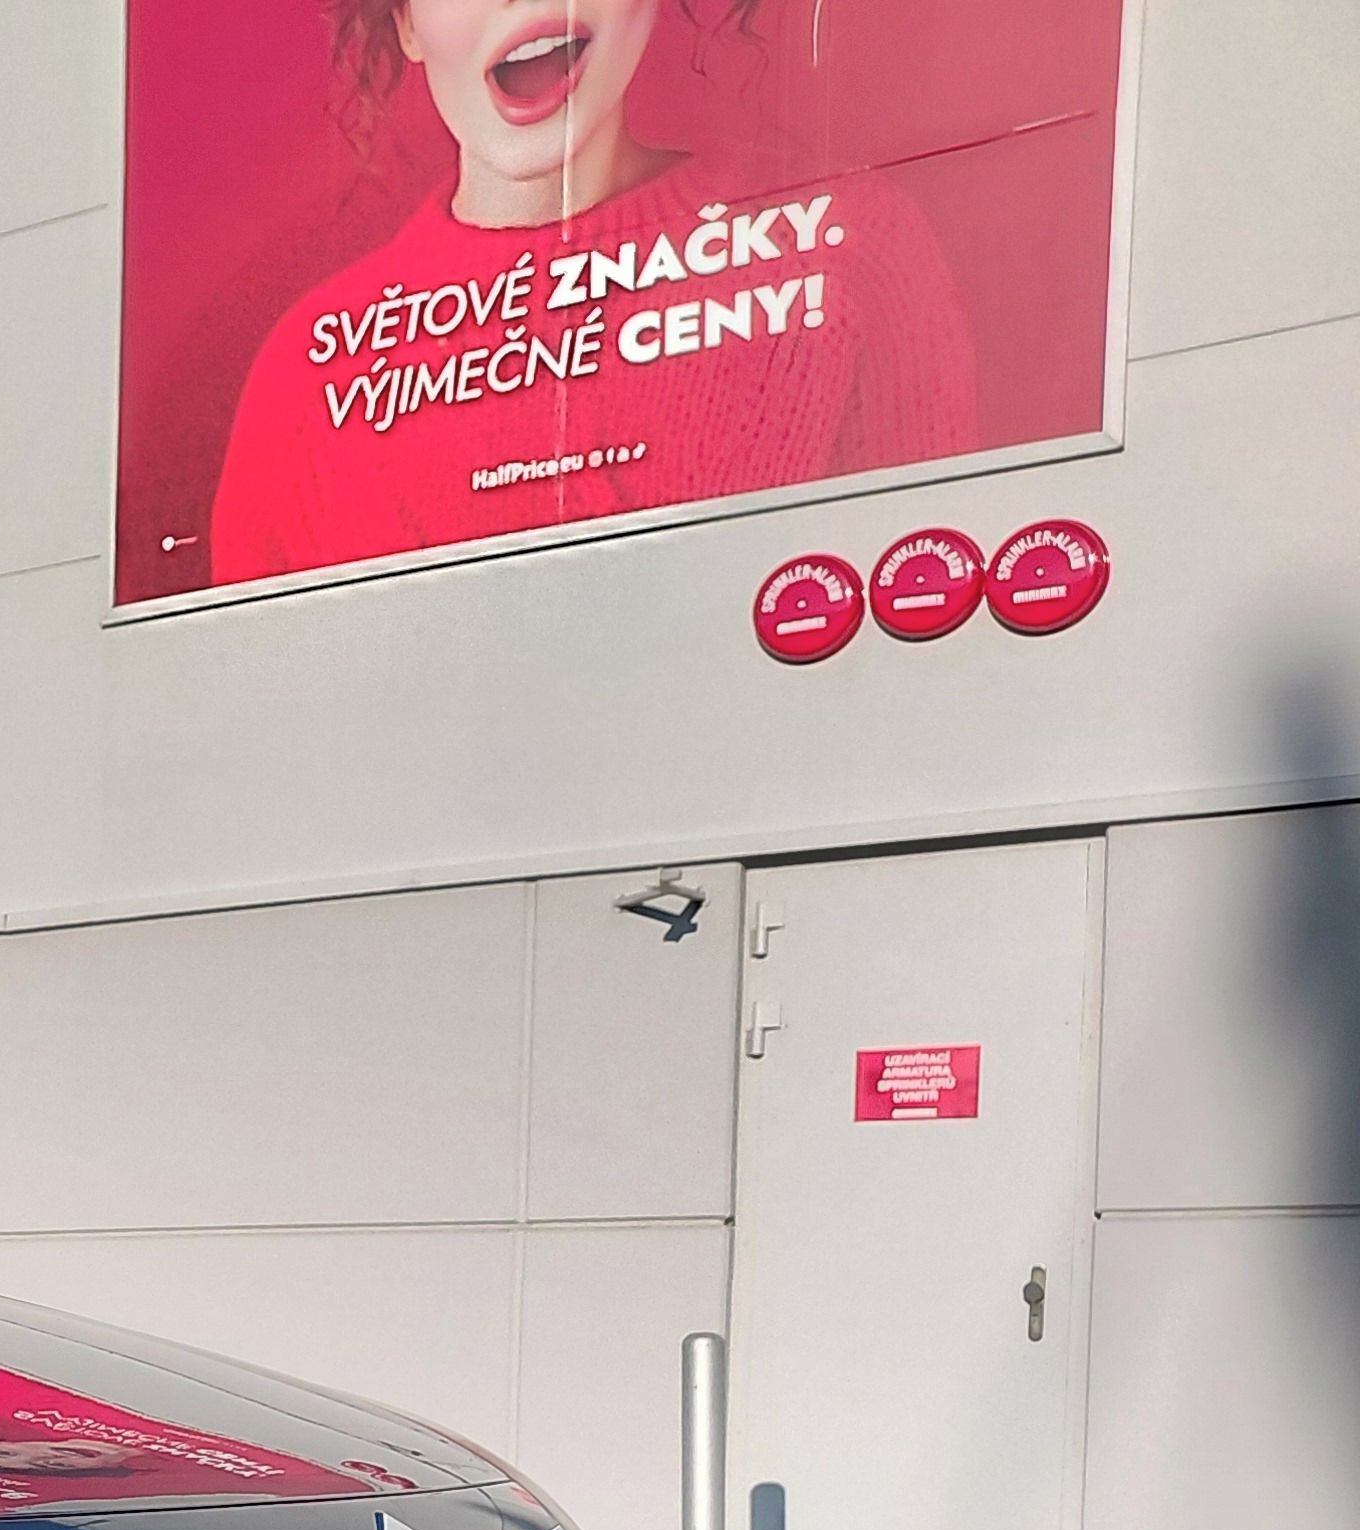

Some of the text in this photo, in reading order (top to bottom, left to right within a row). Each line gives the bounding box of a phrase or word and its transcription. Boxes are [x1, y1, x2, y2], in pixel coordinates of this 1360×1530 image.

[308, 195, 846, 364] SVĚTOVÉ ZNAČKY.
[324, 273, 826, 433] VÝJIMEČNÉ CENY!
